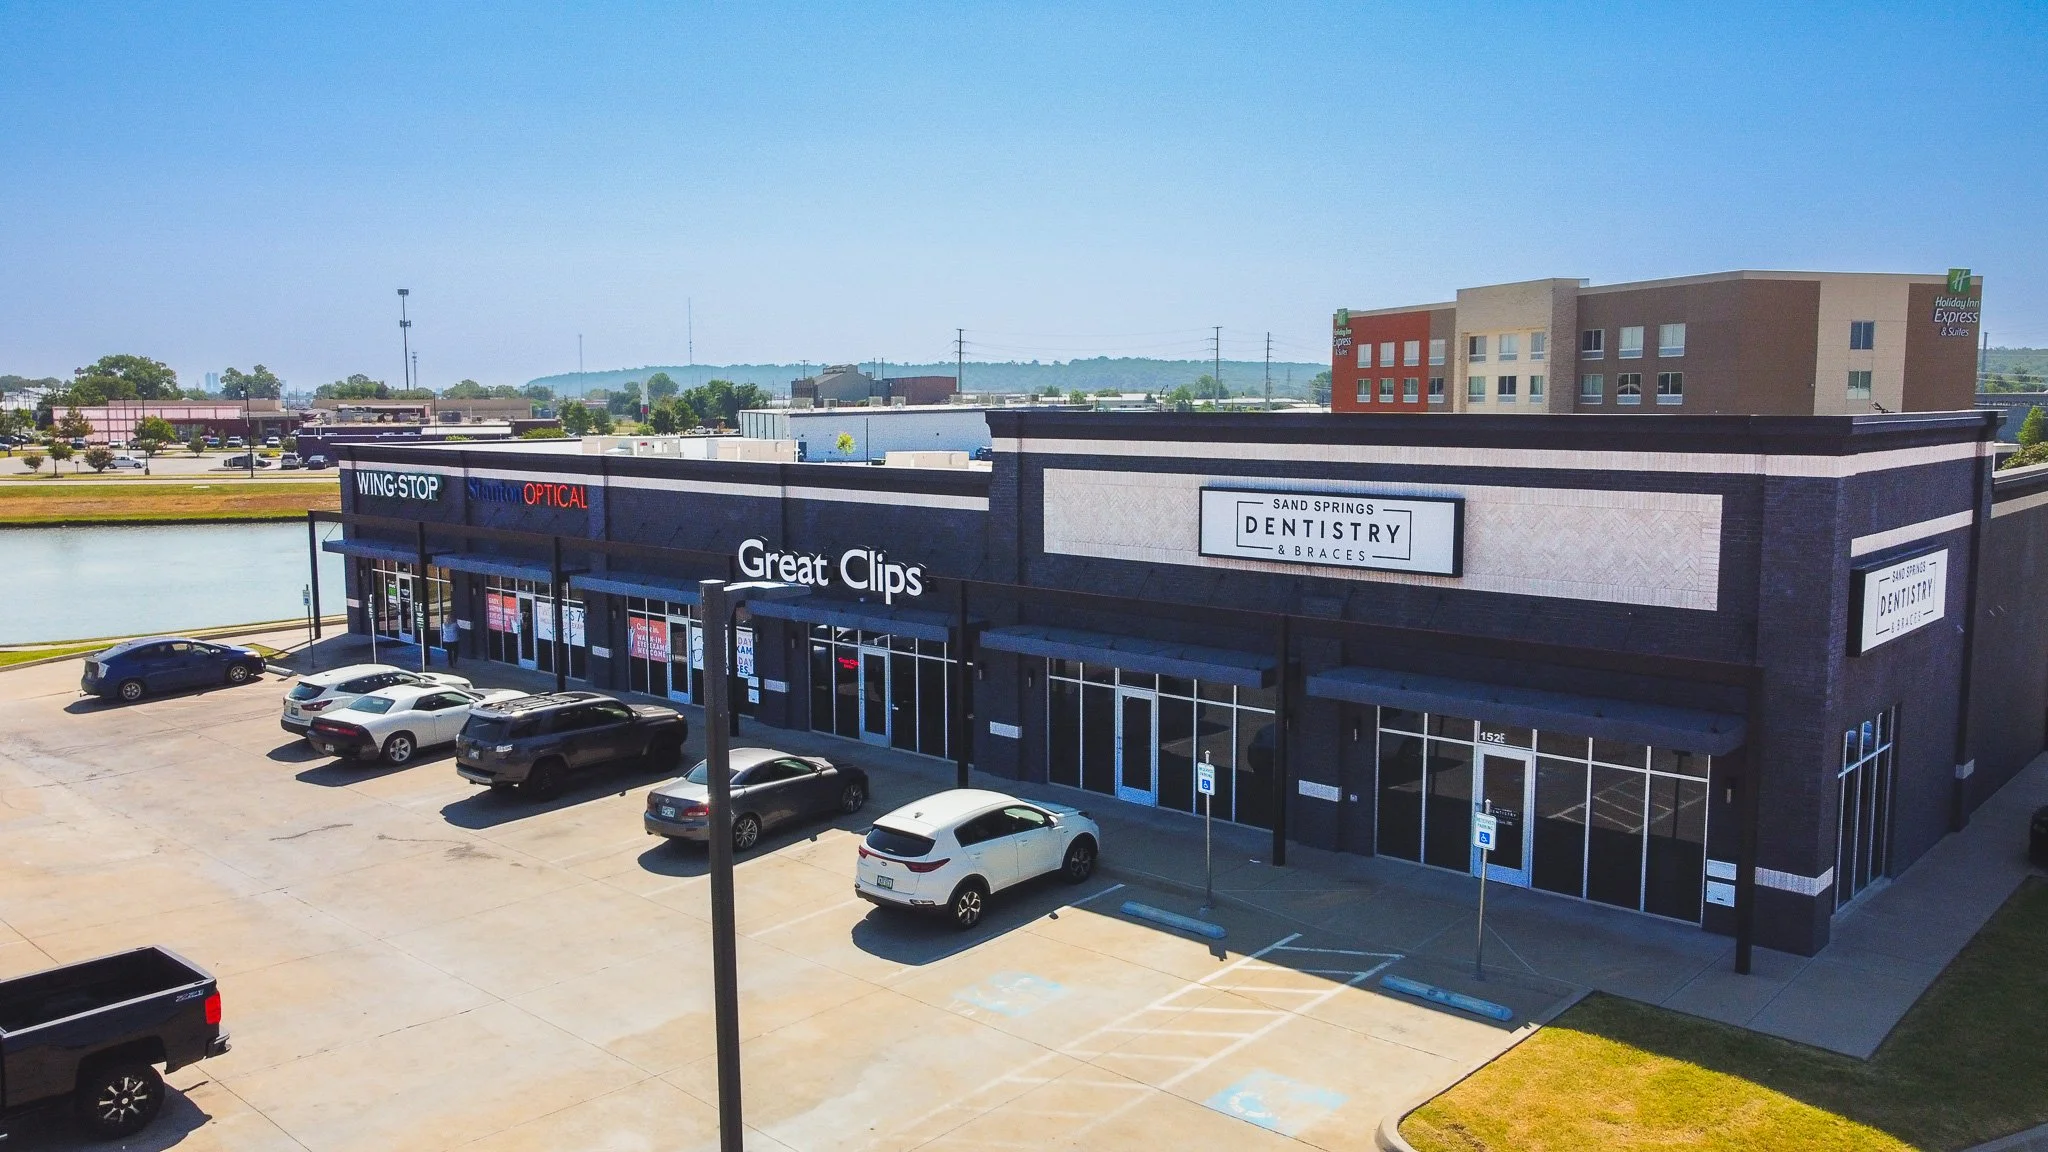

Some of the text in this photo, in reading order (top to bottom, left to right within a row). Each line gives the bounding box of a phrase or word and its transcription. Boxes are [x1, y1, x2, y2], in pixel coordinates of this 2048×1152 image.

[1935, 296, 1980, 310] Holiday Inn
[1934, 308, 1979, 326] Express
[1941, 327, 1969, 337] & Suites
[468, 477, 588, 509] Stanton OPTICAL
[1273, 498, 1374, 515] SAND SPRINGS
[1245, 515, 1401, 544] DENTISTRY
[1277, 545, 1366, 561] & BRACES
[738, 538, 923, 605] Great Clips
[1892, 561, 1926, 583] SAND SPRINGS
[1880, 578, 1933, 617] DENTISTRY
[1896, 611, 1922, 631] BRACES
[637, 633, 662, 644] WAK-IN
[738, 637, 753, 647] DAY
[637, 647, 666, 658] WECOME
[738, 656, 753, 667] DAY
